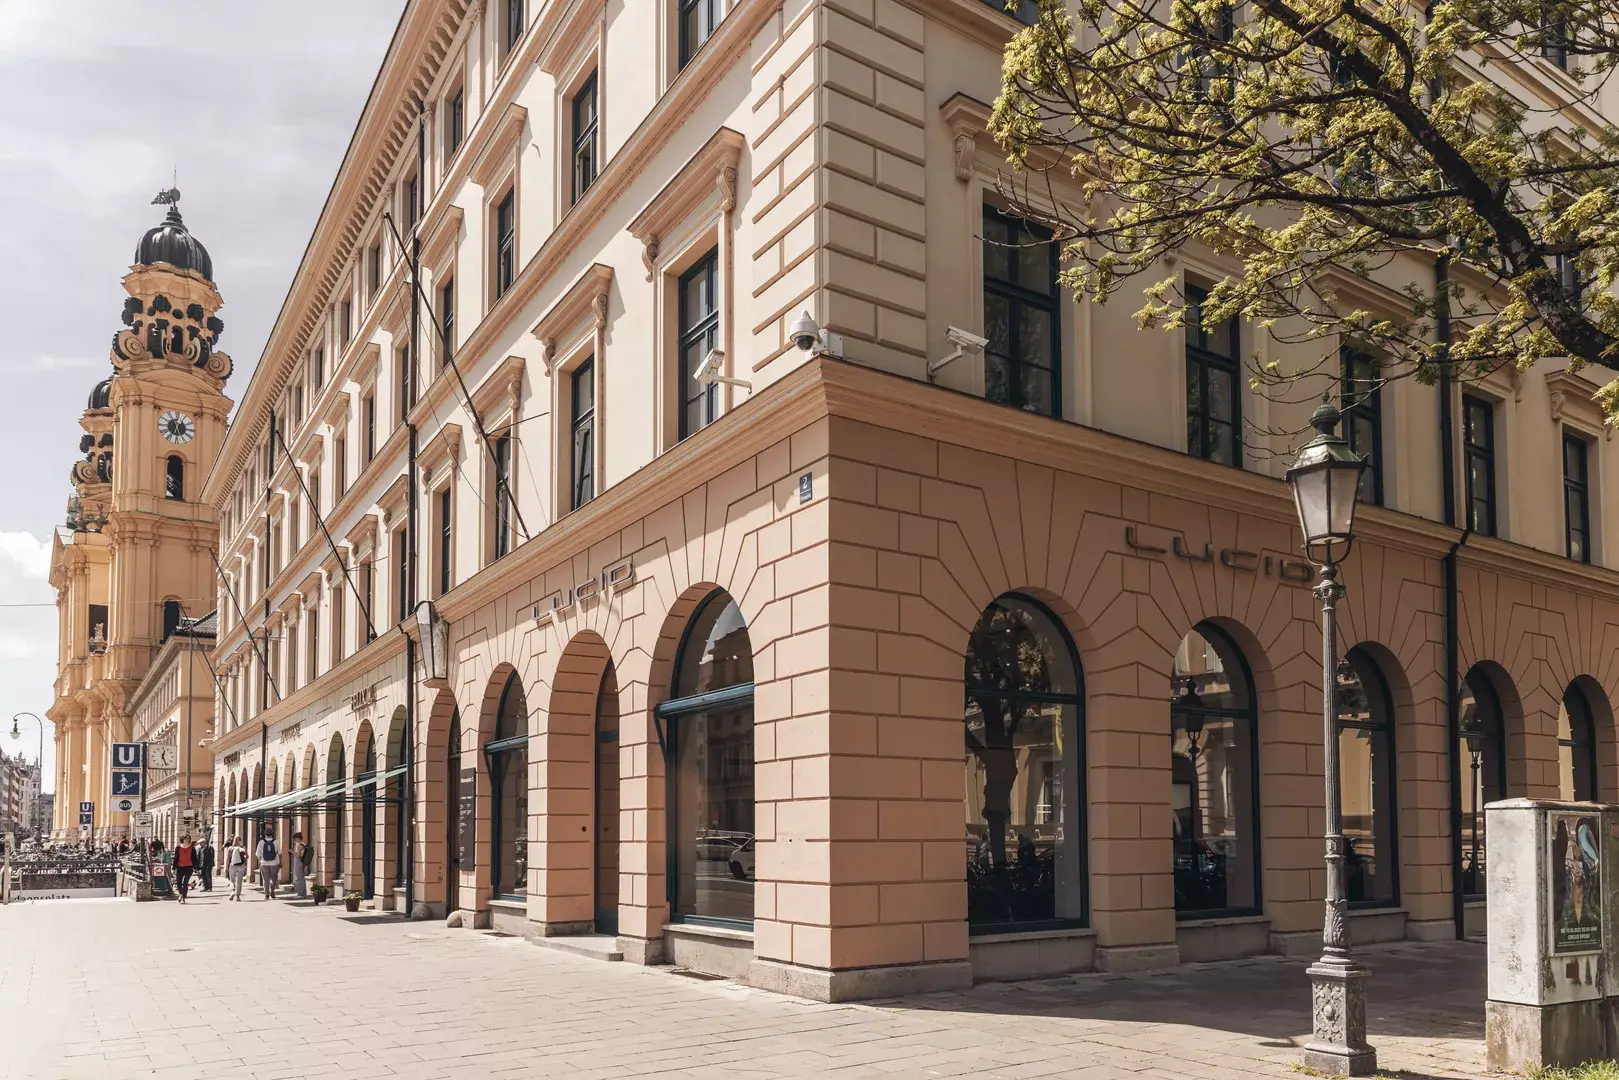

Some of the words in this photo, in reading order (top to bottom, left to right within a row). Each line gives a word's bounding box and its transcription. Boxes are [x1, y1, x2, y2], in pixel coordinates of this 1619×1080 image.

[802, 476, 808, 489] 2
[1125, 526, 1315, 582] LUCID
[532, 560, 634, 621] LUCID
[118, 746, 135, 764] U
[82, 803, 89, 811] U
